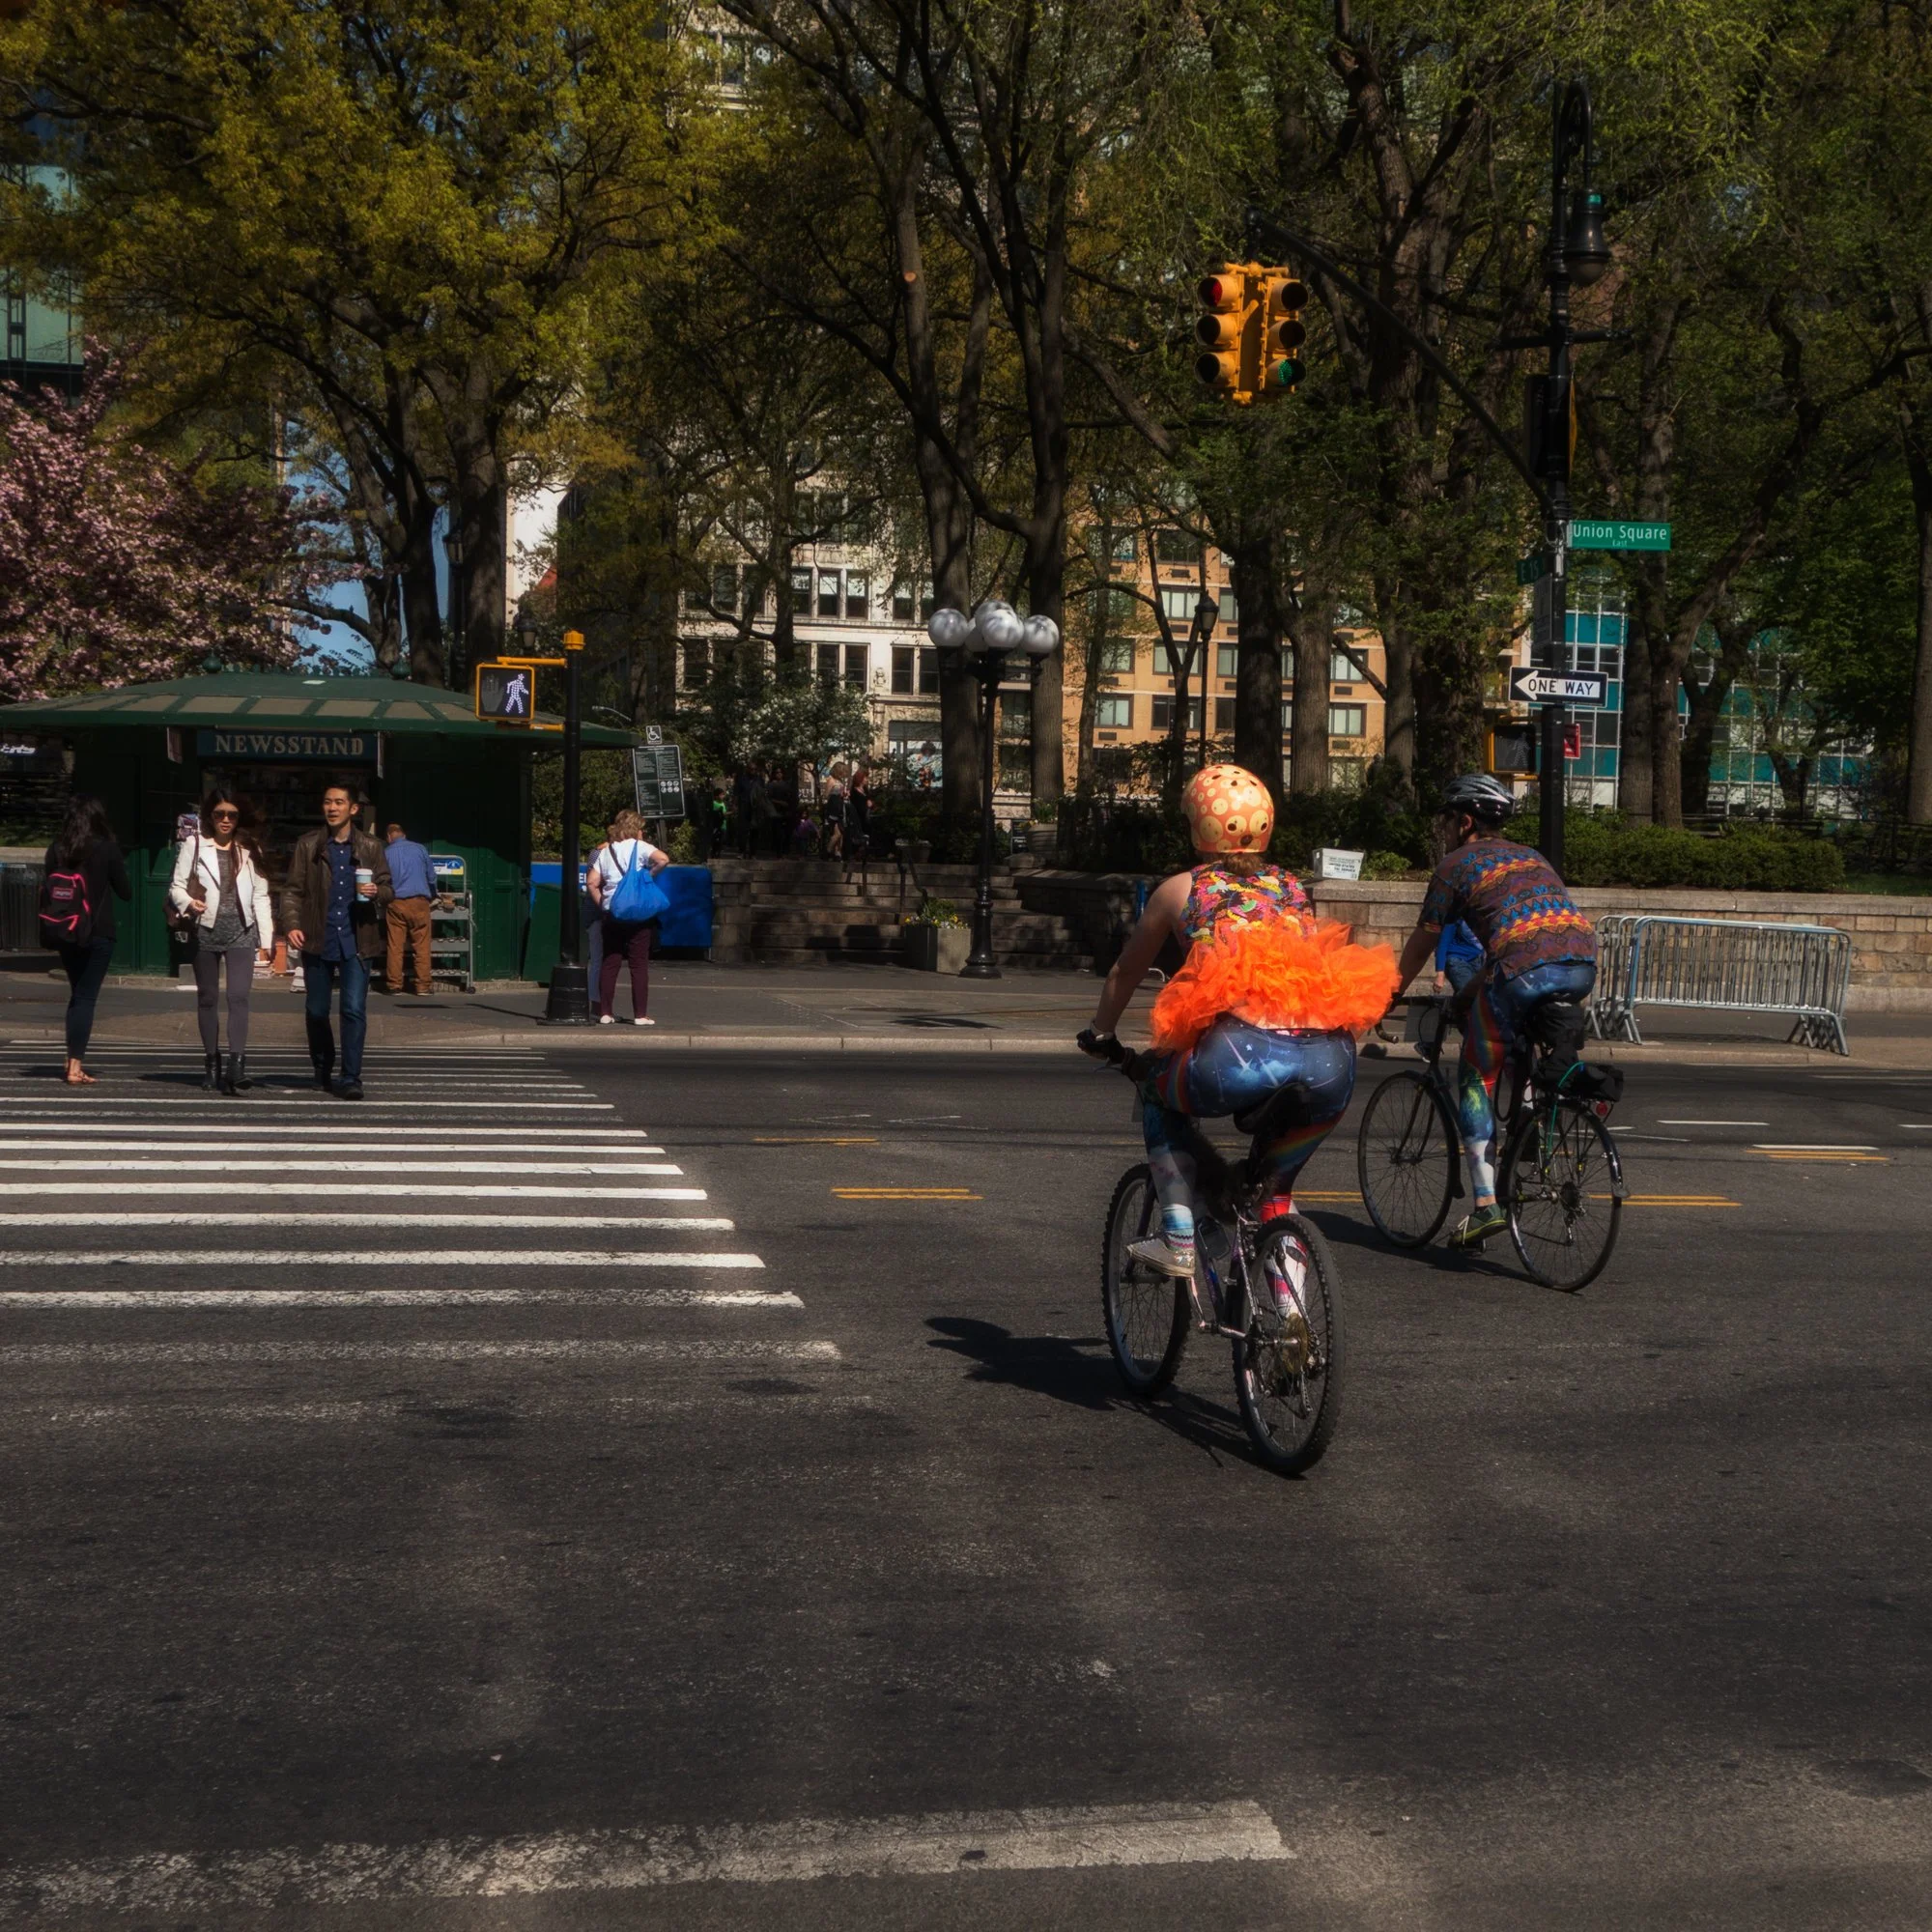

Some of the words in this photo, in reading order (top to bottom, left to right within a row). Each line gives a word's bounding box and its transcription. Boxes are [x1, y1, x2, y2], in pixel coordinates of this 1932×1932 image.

[1574, 524, 1613, 539] Union
[1619, 526, 1667, 542] Square
[1612, 539, 1628, 548] East
[1520, 563, 1526, 582] E
[1528, 678, 1557, 694] ONE
[1565, 681, 1594, 696] WAY
[215, 734, 364, 755] NEWSSTAND
